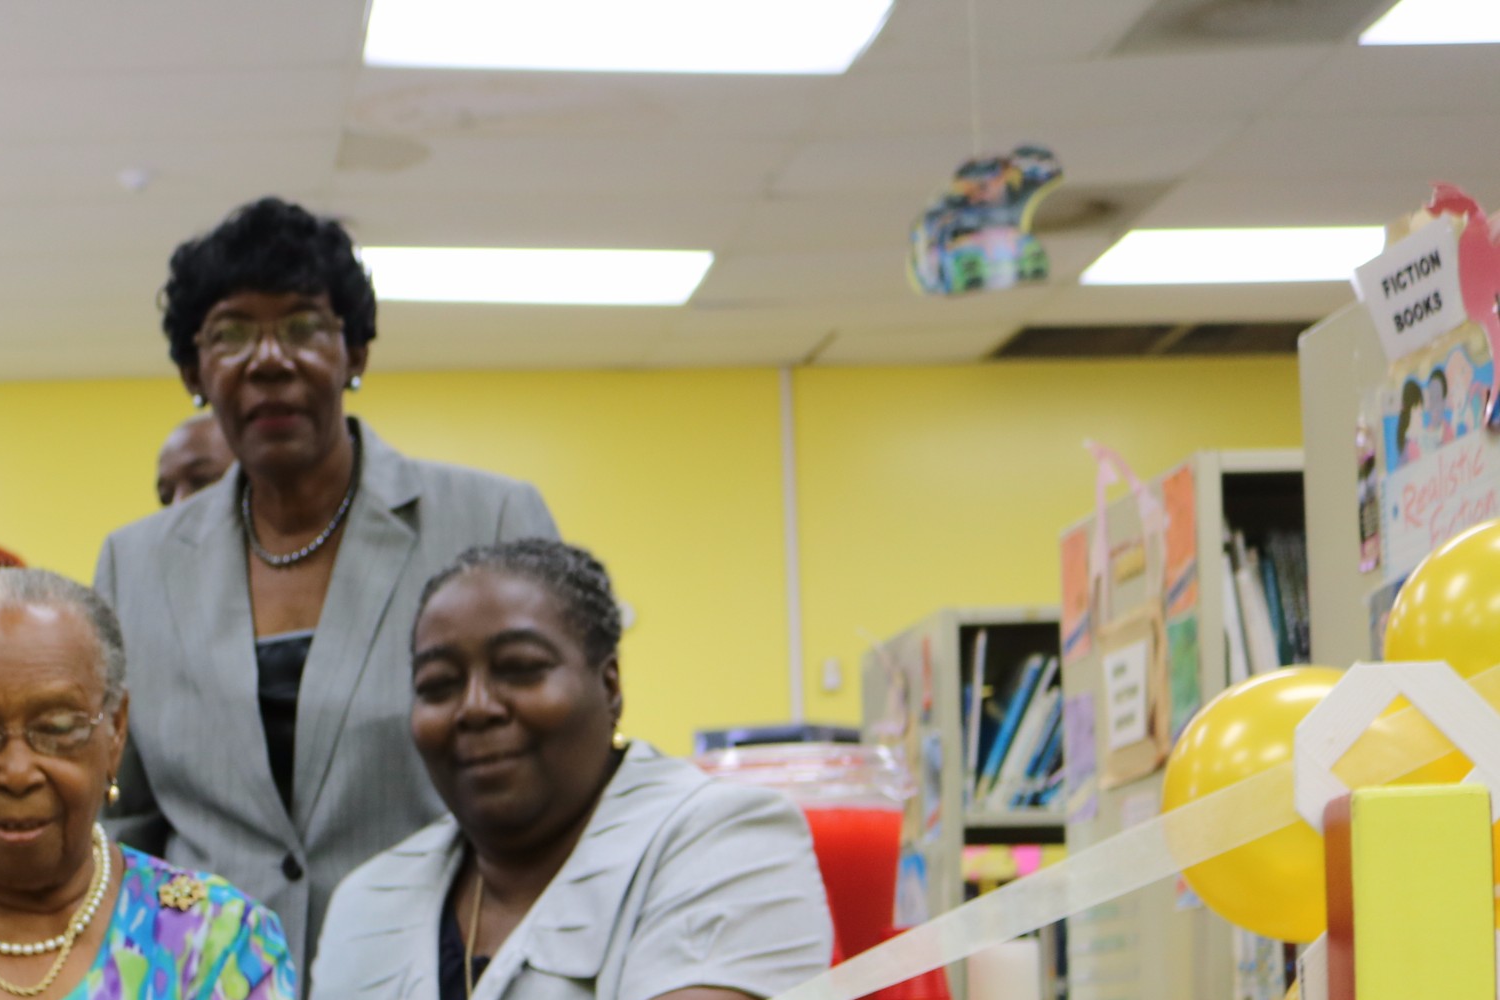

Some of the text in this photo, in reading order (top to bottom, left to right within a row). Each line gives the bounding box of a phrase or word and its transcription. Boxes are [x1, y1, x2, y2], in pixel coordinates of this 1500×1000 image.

[1381, 247, 1441, 299] FICTION
[1393, 290, 1442, 333] BOOKS
[1402, 445, 1483, 531] Realistic
